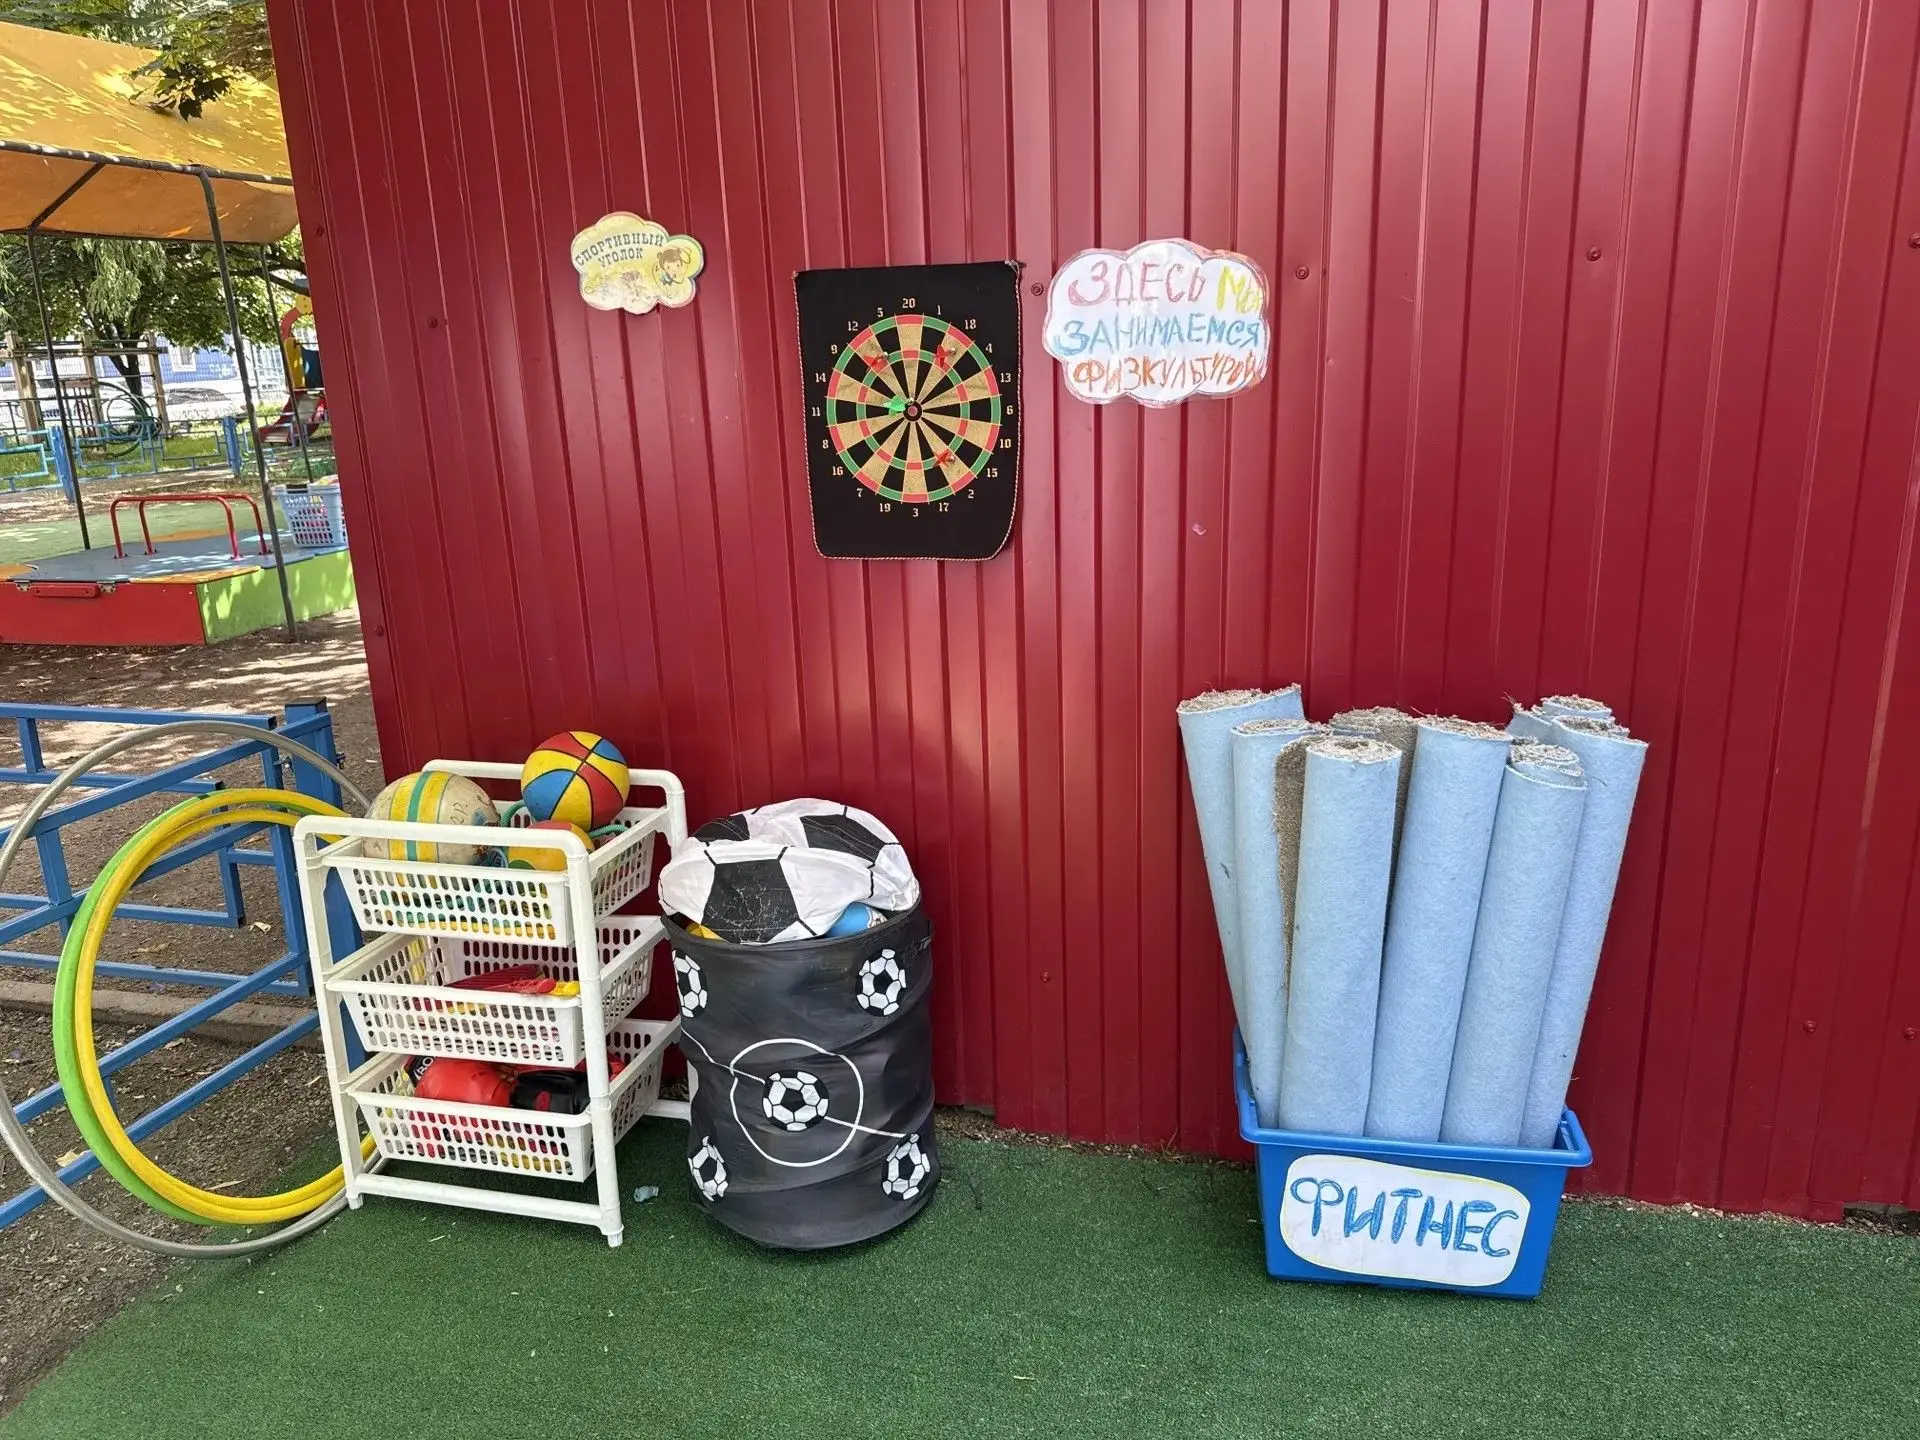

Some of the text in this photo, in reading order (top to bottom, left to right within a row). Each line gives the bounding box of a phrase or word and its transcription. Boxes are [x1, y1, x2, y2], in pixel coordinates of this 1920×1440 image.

[575, 232, 664, 267] СПОРТИВНЫЙ
[596, 247, 644, 268] УГОЛОК
[1067, 260, 1207, 307] ЗДЕСЬ
[902, 298, 916, 308] 20
[877, 307, 884, 318] 5
[936, 305, 942, 315] 1
[847, 321, 859, 331] 12
[964, 318, 977, 330] 18
[1053, 313, 1260, 356] ЗАНИМАЕМСЯ
[831, 344, 838, 354] 9
[985, 343, 993, 353] 4
[815, 372, 827, 383] 14
[1000, 372, 1012, 383] 13
[811, 406, 821, 416] 11
[1006, 405, 1014, 415] 6
[822, 439, 829, 449] 8
[1000, 438, 1012, 449] 10
[832, 466, 844, 476] 16
[986, 467, 998, 477] 15
[856, 487, 863, 497] 7
[968, 489, 975, 499] 2
[879, 502, 891, 512] 19
[938, 502, 950, 512] 17
[912, 508, 919, 518] 3
[1290, 1177, 1519, 1257] ФИТНЕС
